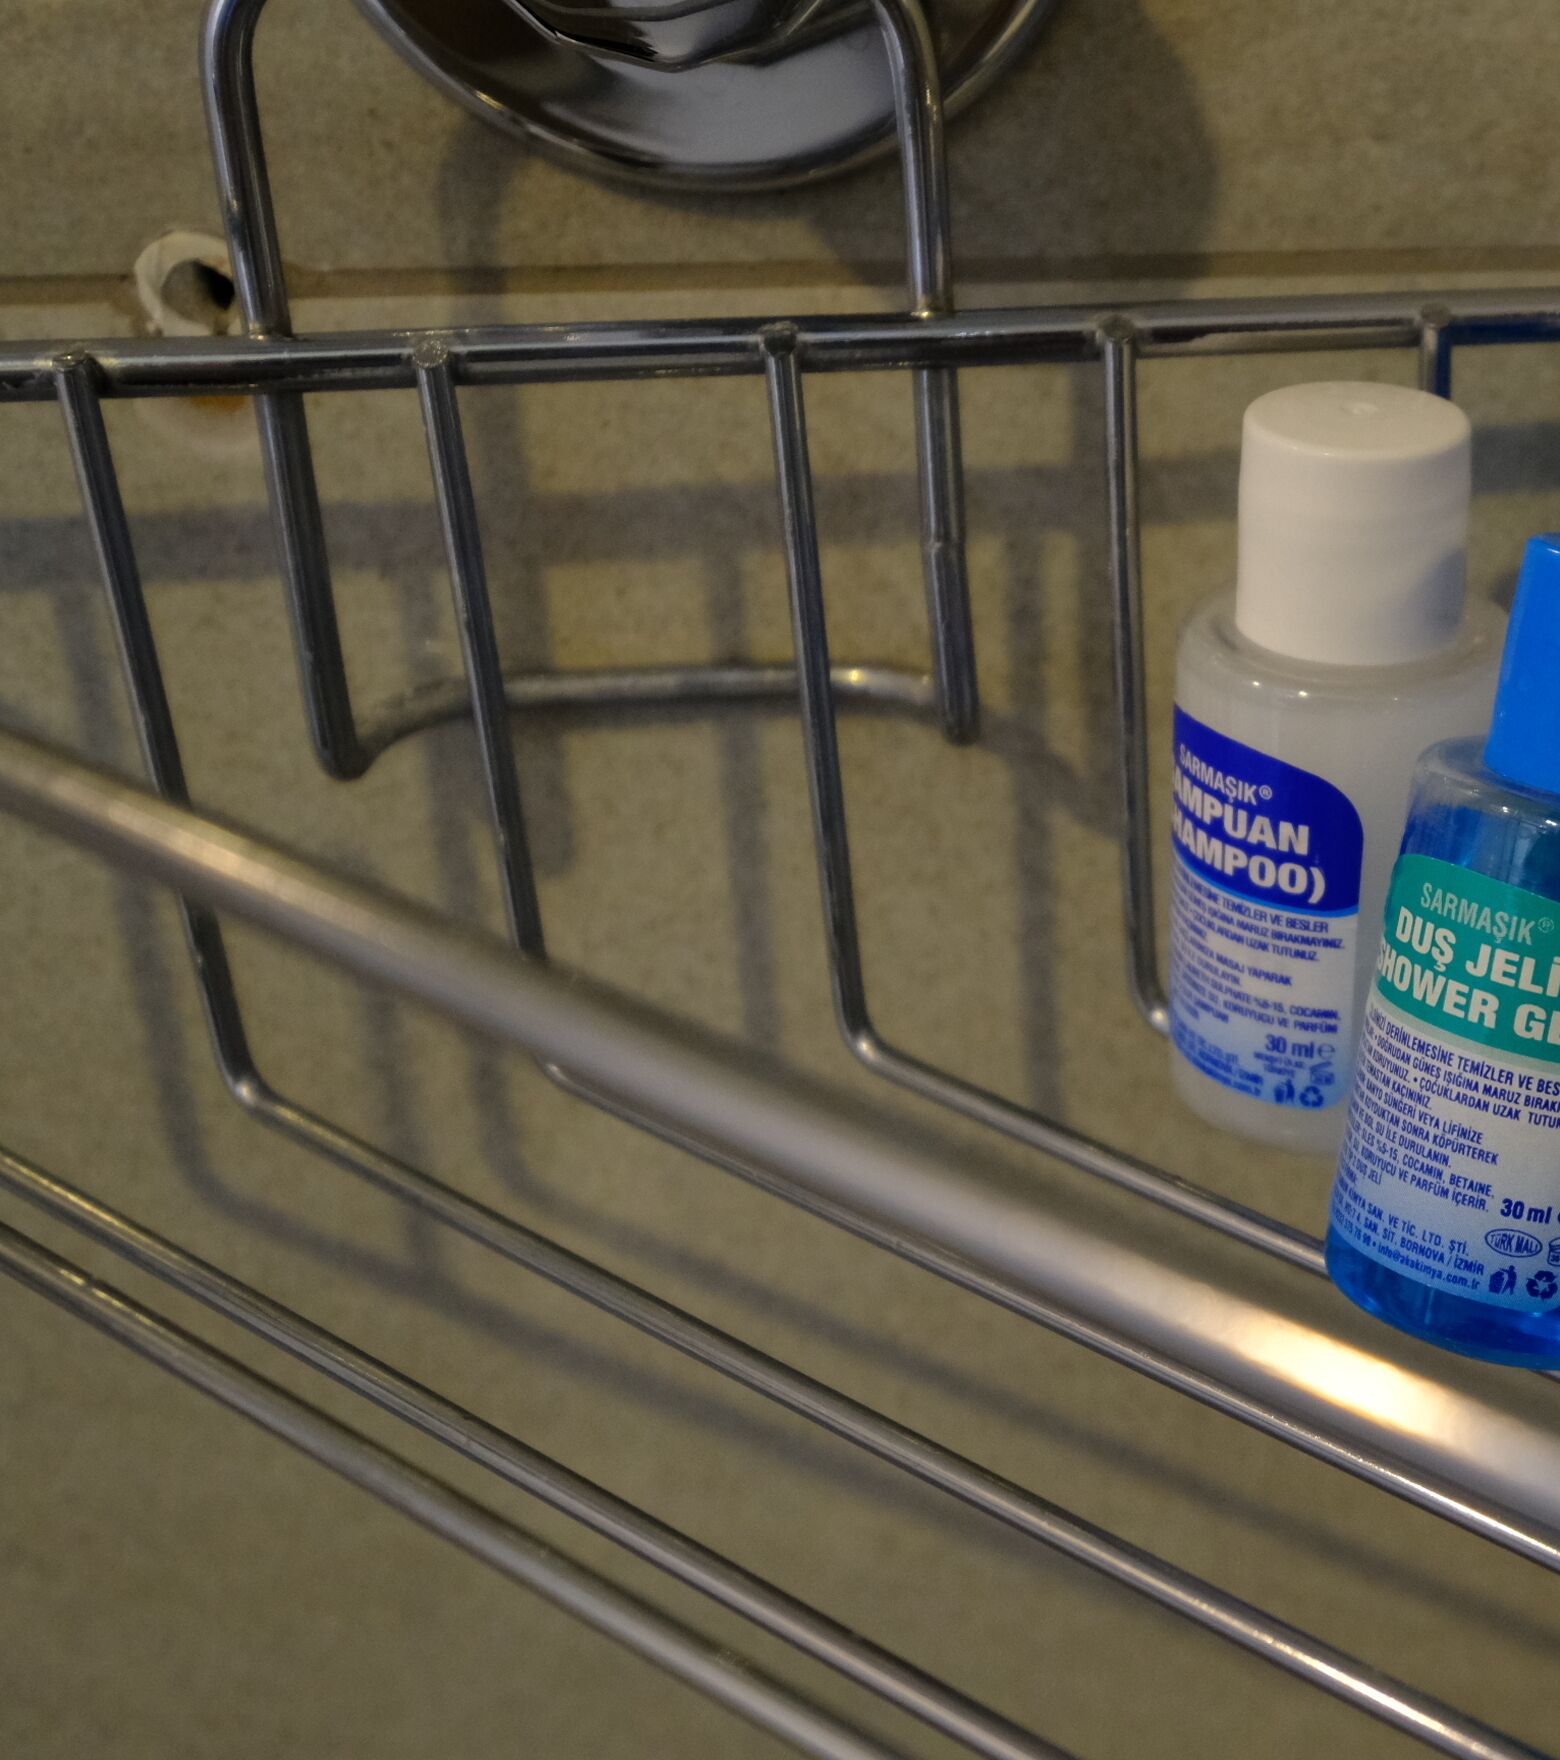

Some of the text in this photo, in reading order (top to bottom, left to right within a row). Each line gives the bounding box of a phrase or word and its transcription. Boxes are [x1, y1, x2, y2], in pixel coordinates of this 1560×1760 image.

[1172, 767, 1309, 856] AMPUAN
[1172, 805, 1325, 904] HAMPOO)
[1395, 905, 1457, 972] DUŞ
[1377, 942, 1499, 1029] SHOWER
[1265, 1034, 1287, 1053] 30
[1291, 1041, 1314, 1059] ml
[1412, 1056, 1441, 1082] GÜNEŞ
[1481, 1085, 1520, 1105] MARUZ
[1458, 1055, 1514, 1086] TEMİZLER
[1518, 1073, 1535, 1090] VE
[1385, 1091, 1416, 1119] SÜNGERİ
[1418, 1109, 1440, 1130] VEYA
[1443, 1119, 1484, 1145] LİFİNİZE
[1419, 1076, 1490, 1113] ÇOCUKLARDAN
[1492, 1103, 1522, 1121] UZAK
[1401, 1118, 1430, 1143] SONRA
[1432, 1132, 1499, 1166] KÖPÜRTEREK
[1399, 1168, 1408, 1183] VE
[1410, 1174, 1449, 1200] PARFÜM
[1451, 1188, 1488, 1212] İÇERİR.
[1500, 1197, 1525, 1220] 30
[1526, 1206, 1552, 1225] ml
[1388, 1213, 1399, 1228] VE
[1401, 1219, 1417, 1239] TİC.
[1421, 1229, 1443, 1249] LTD.
[1448, 1238, 1469, 1256] ŞTİ.
[1400, 1236, 1445, 1264] BORNOVA
[1453, 1253, 1485, 1276] İZMİR
